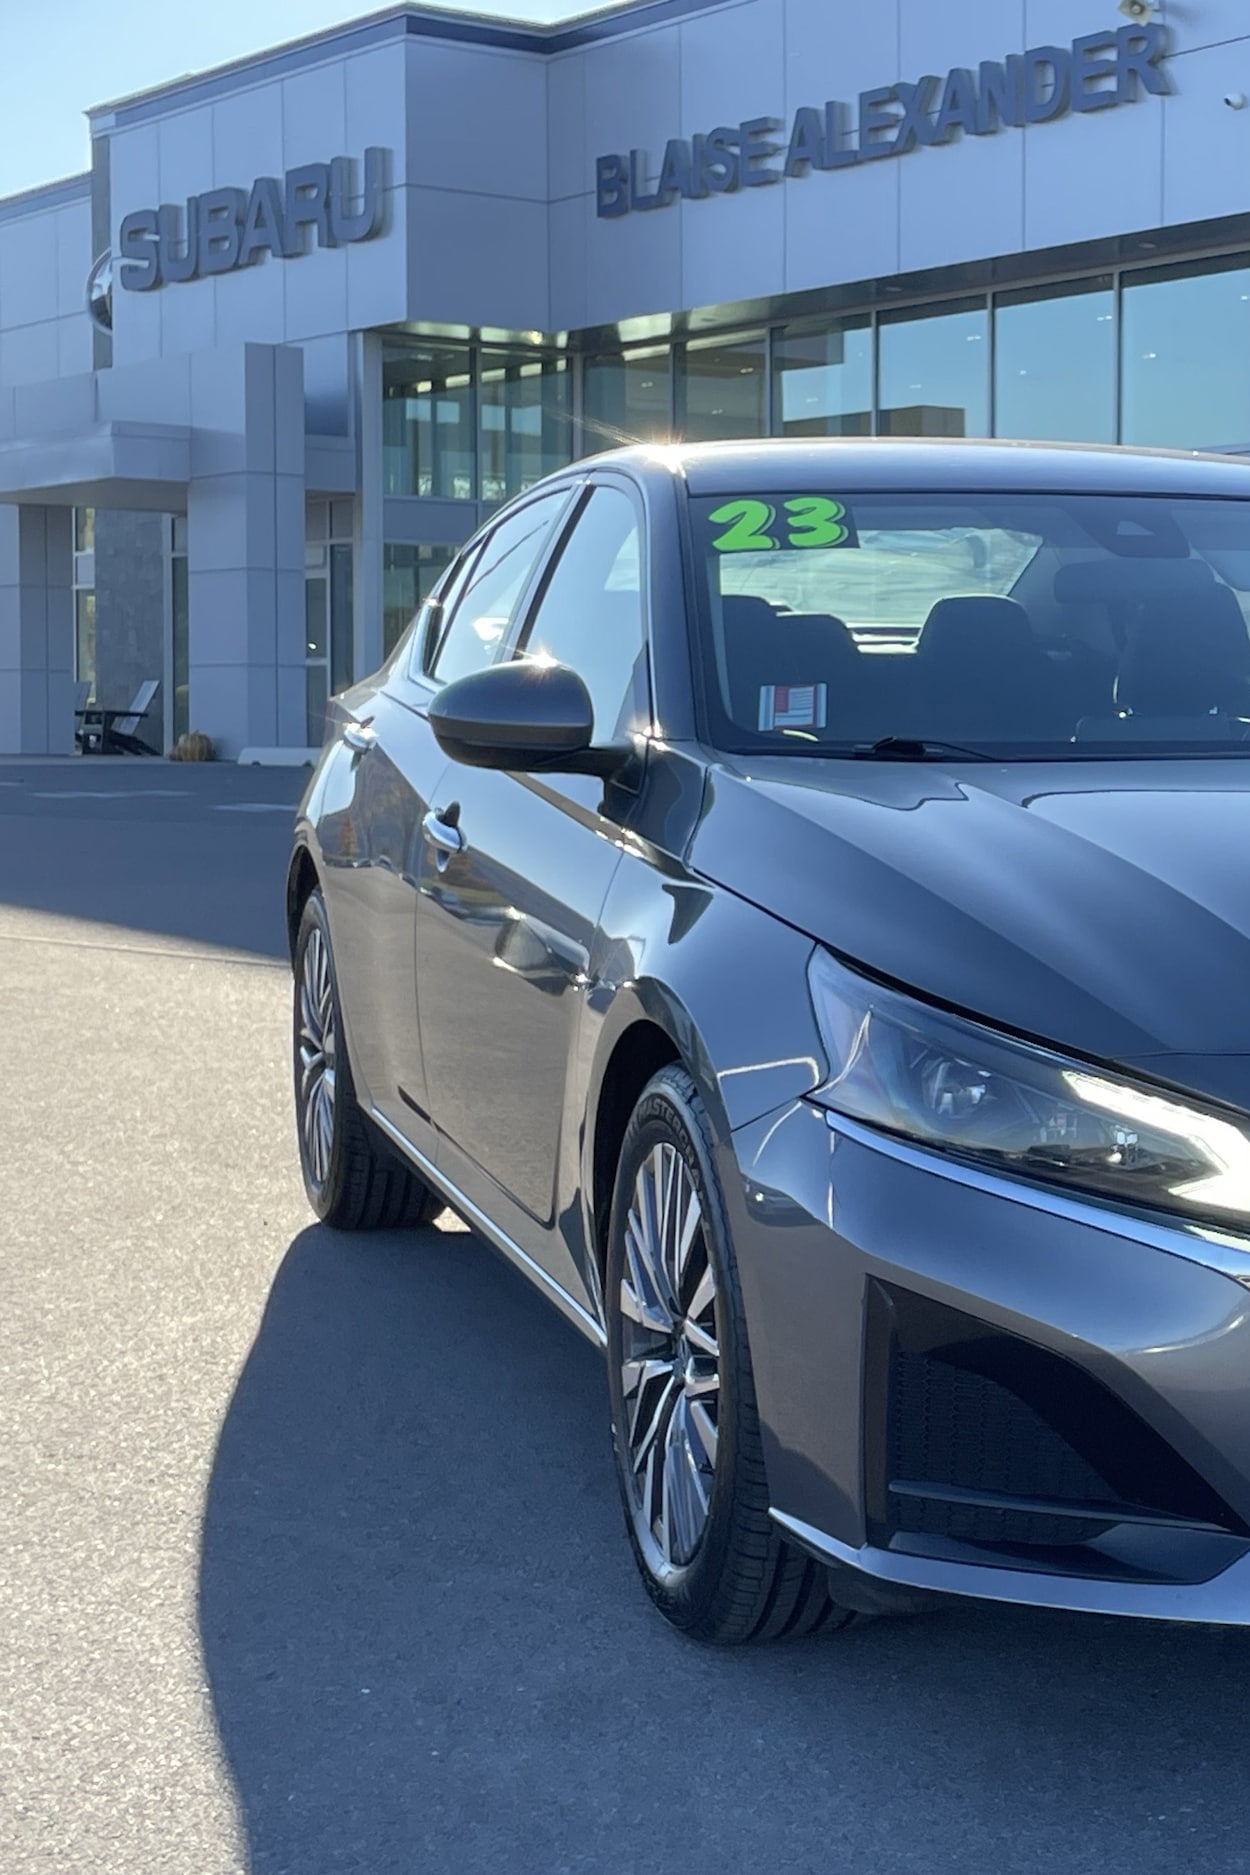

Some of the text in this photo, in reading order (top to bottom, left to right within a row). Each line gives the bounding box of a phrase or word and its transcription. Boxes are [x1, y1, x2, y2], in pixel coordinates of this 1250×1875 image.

[596, 22, 1175, 219] BLAISE ALEXANDER
[120, 146, 392, 292] SUBARU
[708, 496, 849, 551] 23
